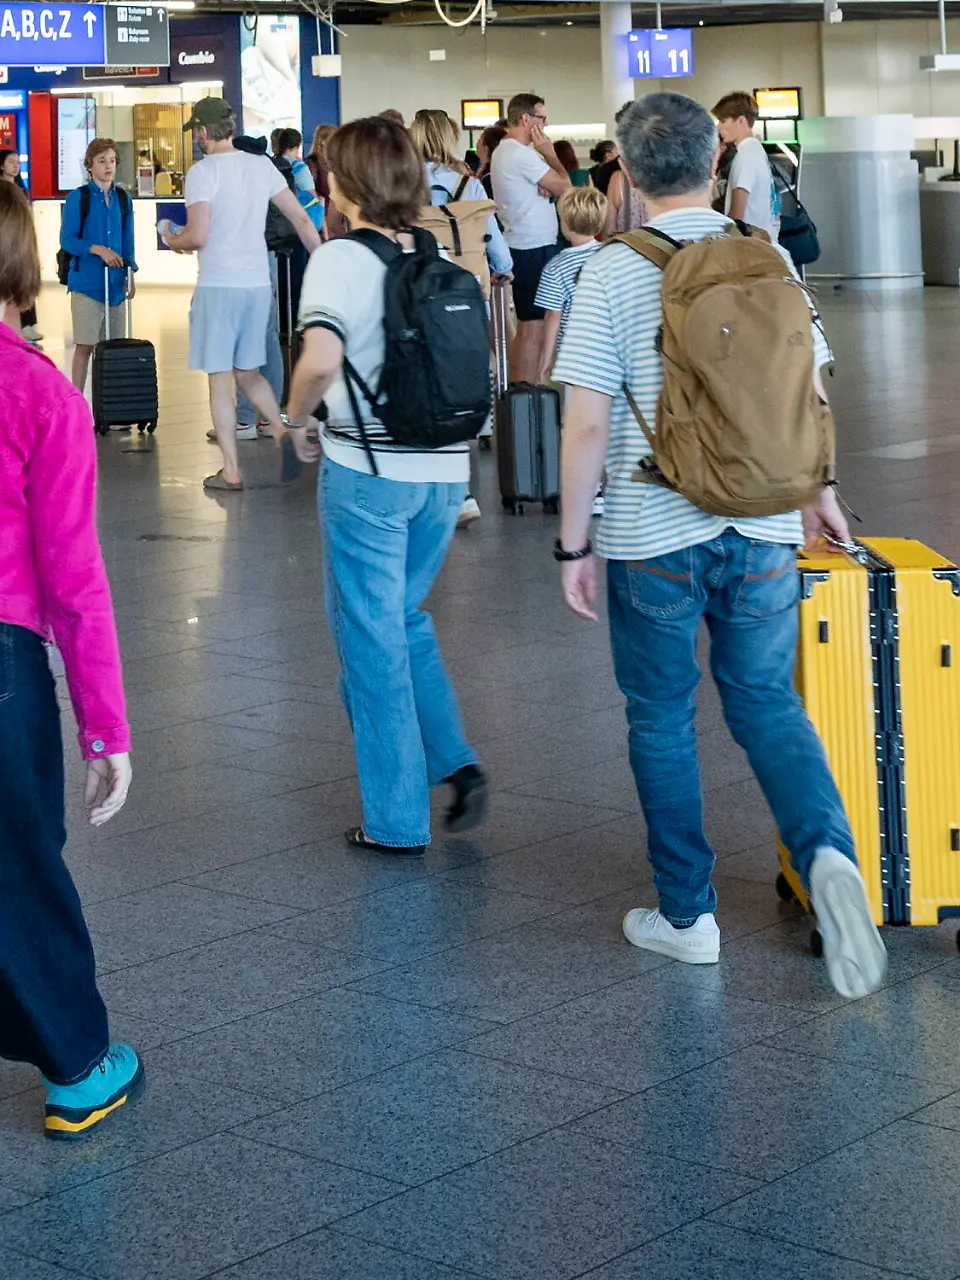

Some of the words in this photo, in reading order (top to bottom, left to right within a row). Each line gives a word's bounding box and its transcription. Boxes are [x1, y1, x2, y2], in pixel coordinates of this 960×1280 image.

[0, 8, 73, 41] A,B,C,Z
[637, 50, 650, 74] 11
[668, 48, 689, 73] 11
